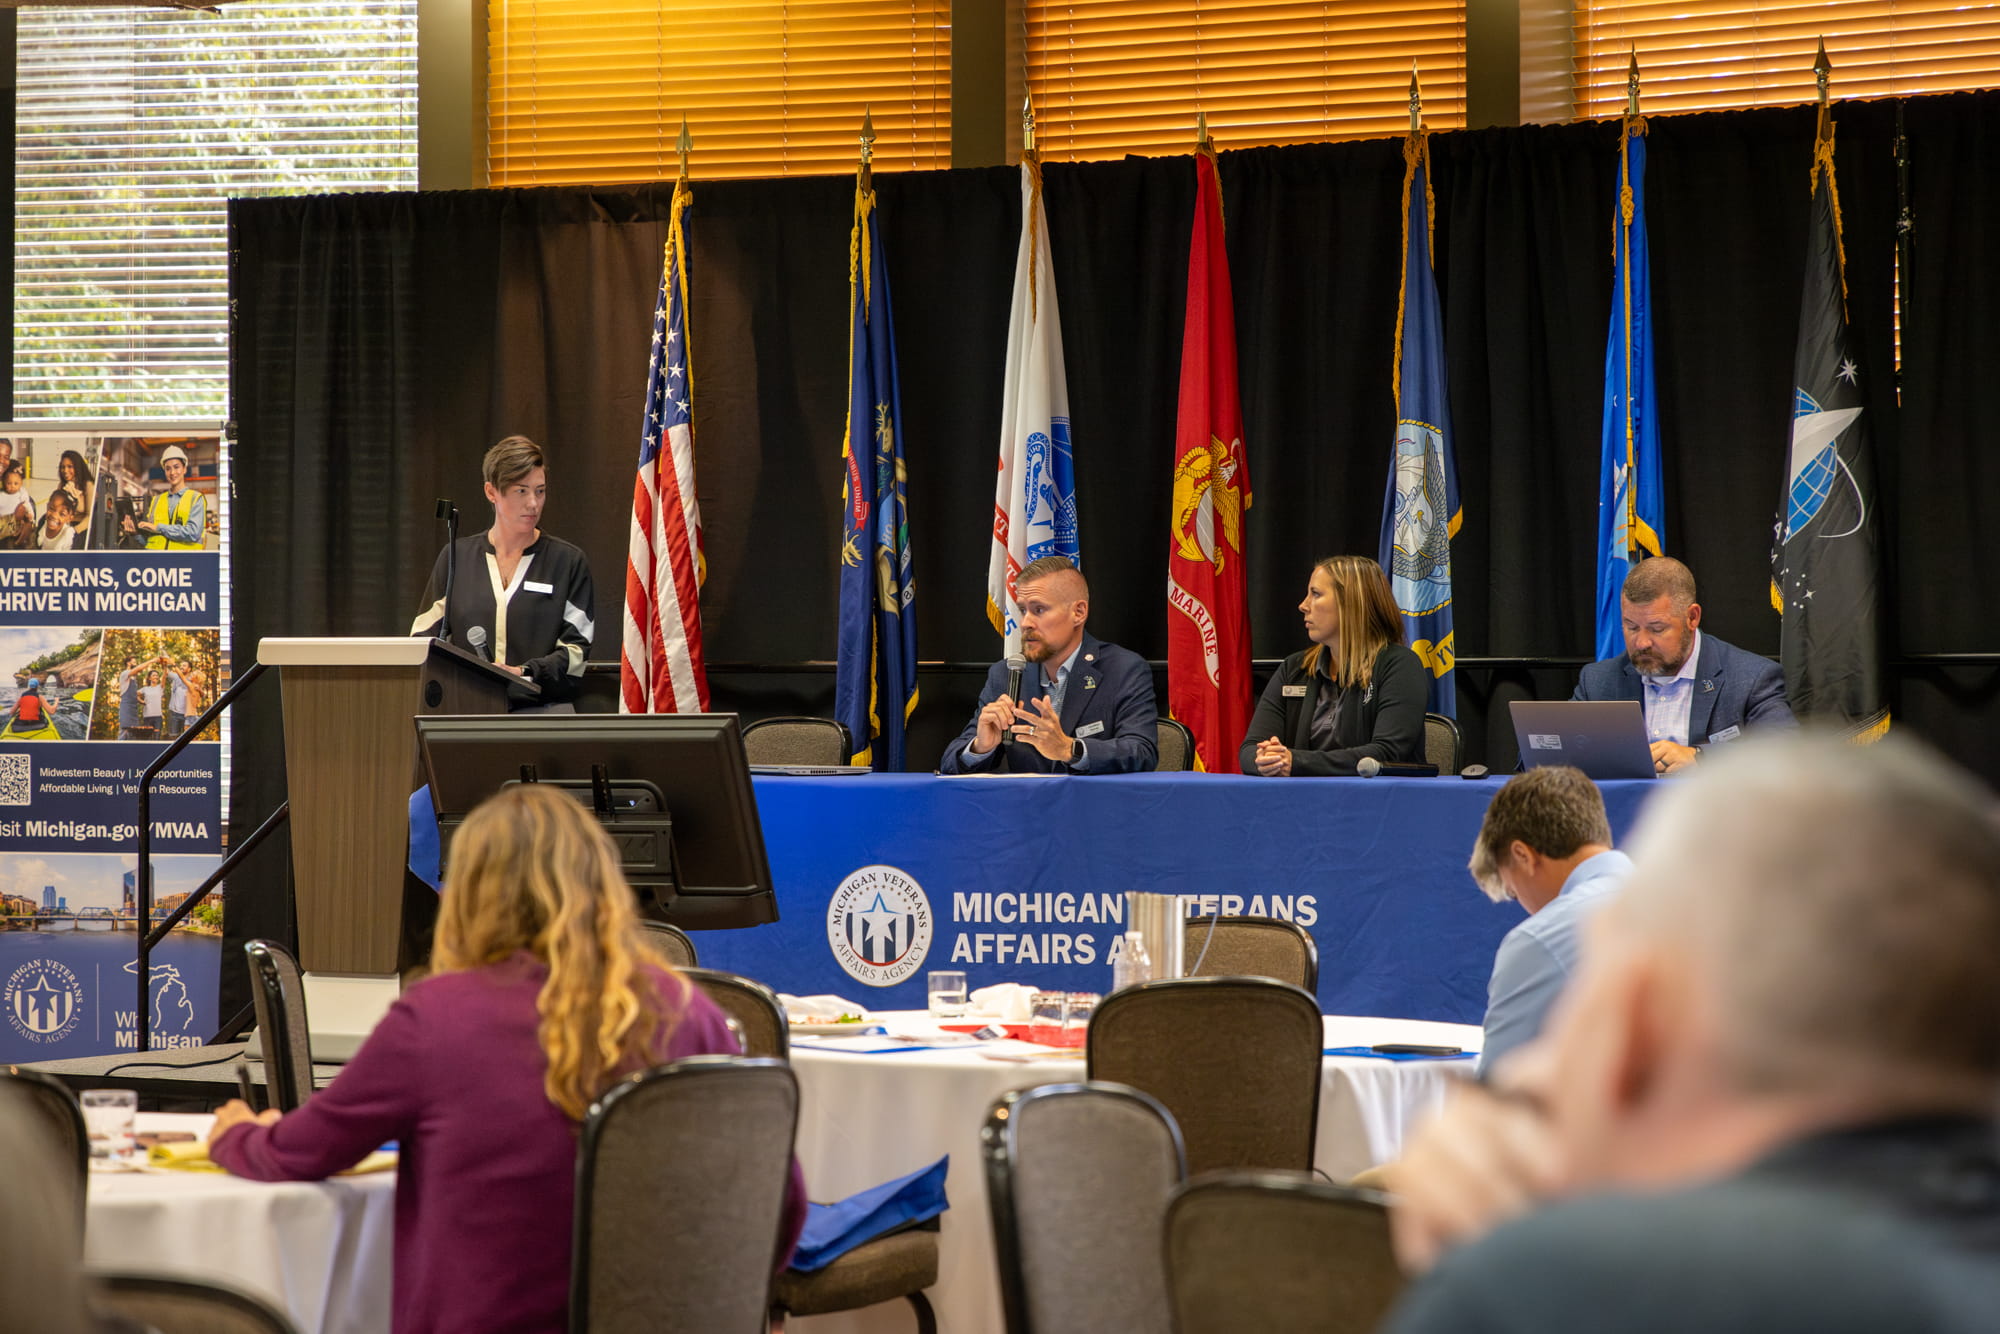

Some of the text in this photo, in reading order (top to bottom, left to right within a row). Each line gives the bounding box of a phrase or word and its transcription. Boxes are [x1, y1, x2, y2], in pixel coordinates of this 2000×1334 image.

[854, 486, 862, 512] UNUM
[0, 567, 193, 591] VETERANS, COME
[0, 592, 206, 612] HRIVE IN MICHIGAN
[1170, 586, 1218, 656] MARINE
[39, 767, 91, 778] Midwestern
[93, 767, 126, 780] Beauty
[134, 768, 147, 778] Jo
[39, 783, 207, 796] Affordable Living Vetn Resources
[0, 820, 22, 837] isit
[833, 872, 928, 928] MICHIGAN VETERANS
[953, 892, 1318, 927] MICHIGAN TERANS
[837, 942, 924, 981] AFFAIRS AGENCY
[951, 933, 1096, 965] AFFAIRS
[4, 959, 83, 1004] MICHIGAN VETERANS
[8, 1013, 80, 1044] AFFAIRS AGENCY
[114, 1010, 152, 1028] Wh
[115, 1030, 203, 1050] Mihigan
